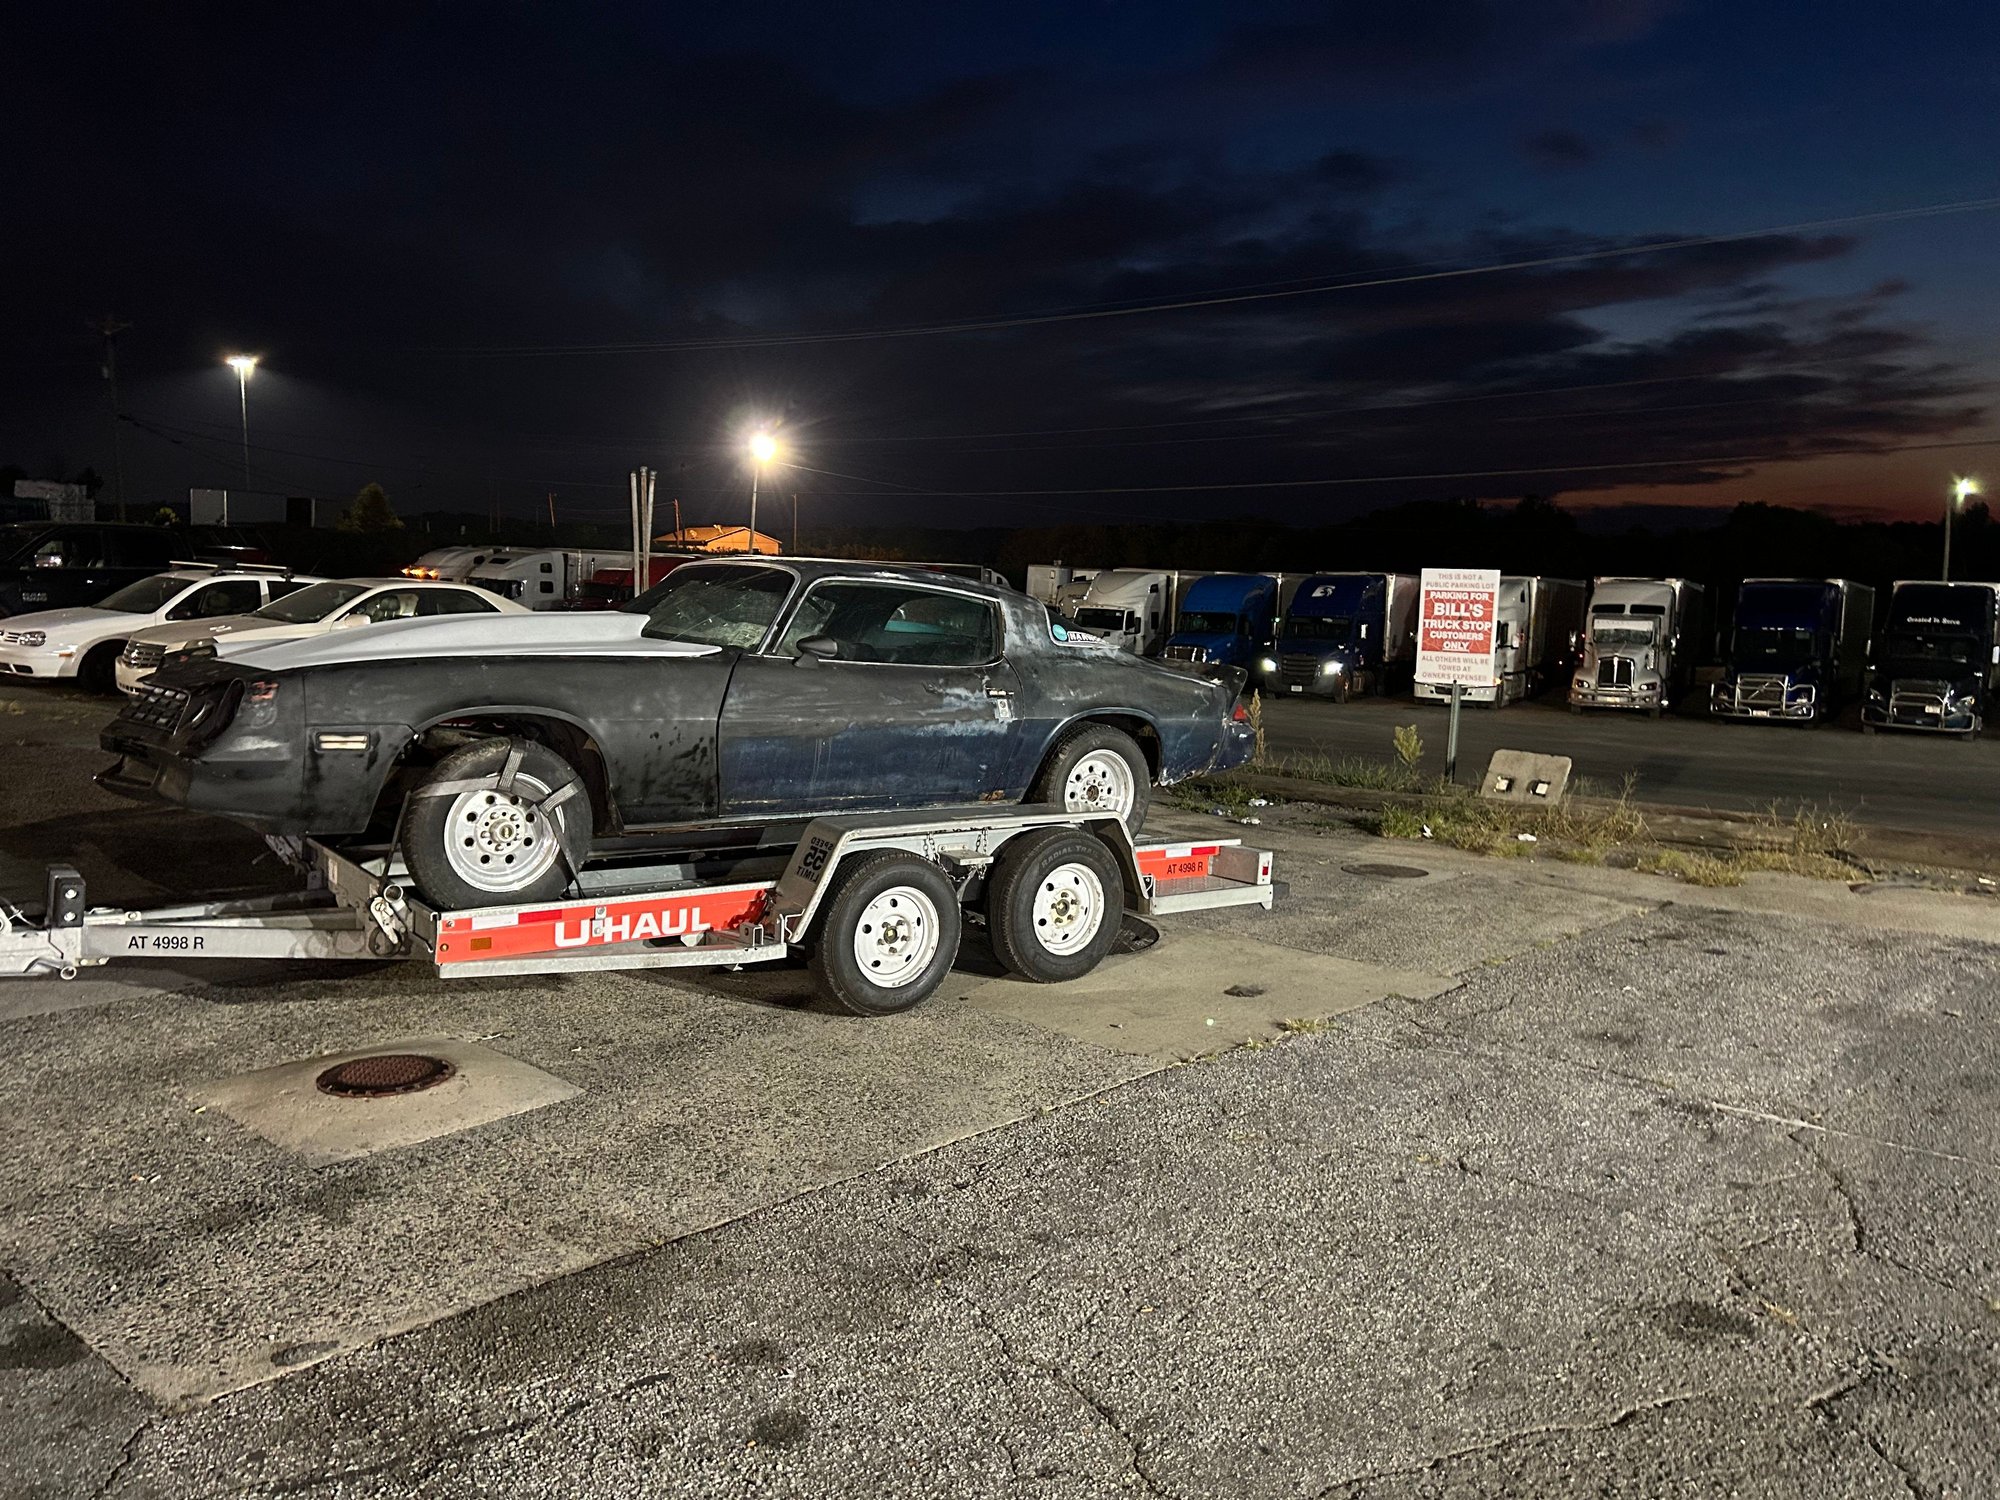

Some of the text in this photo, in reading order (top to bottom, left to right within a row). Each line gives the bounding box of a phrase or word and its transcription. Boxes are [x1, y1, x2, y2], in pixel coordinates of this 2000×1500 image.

[1430, 591, 1489, 601] PARKING FOR
[1433, 602, 1484, 618] BILL'S
[1423, 619, 1492, 631] TRUCK STOP
[1430, 631, 1484, 641] CUSTOMERS
[1443, 641, 1469, 650] ONLY
[1041, 847, 1073, 868] RADIAL
[1166, 861, 1204, 875] AT 4998 R
[127, 935, 204, 950] AT 4998 R
